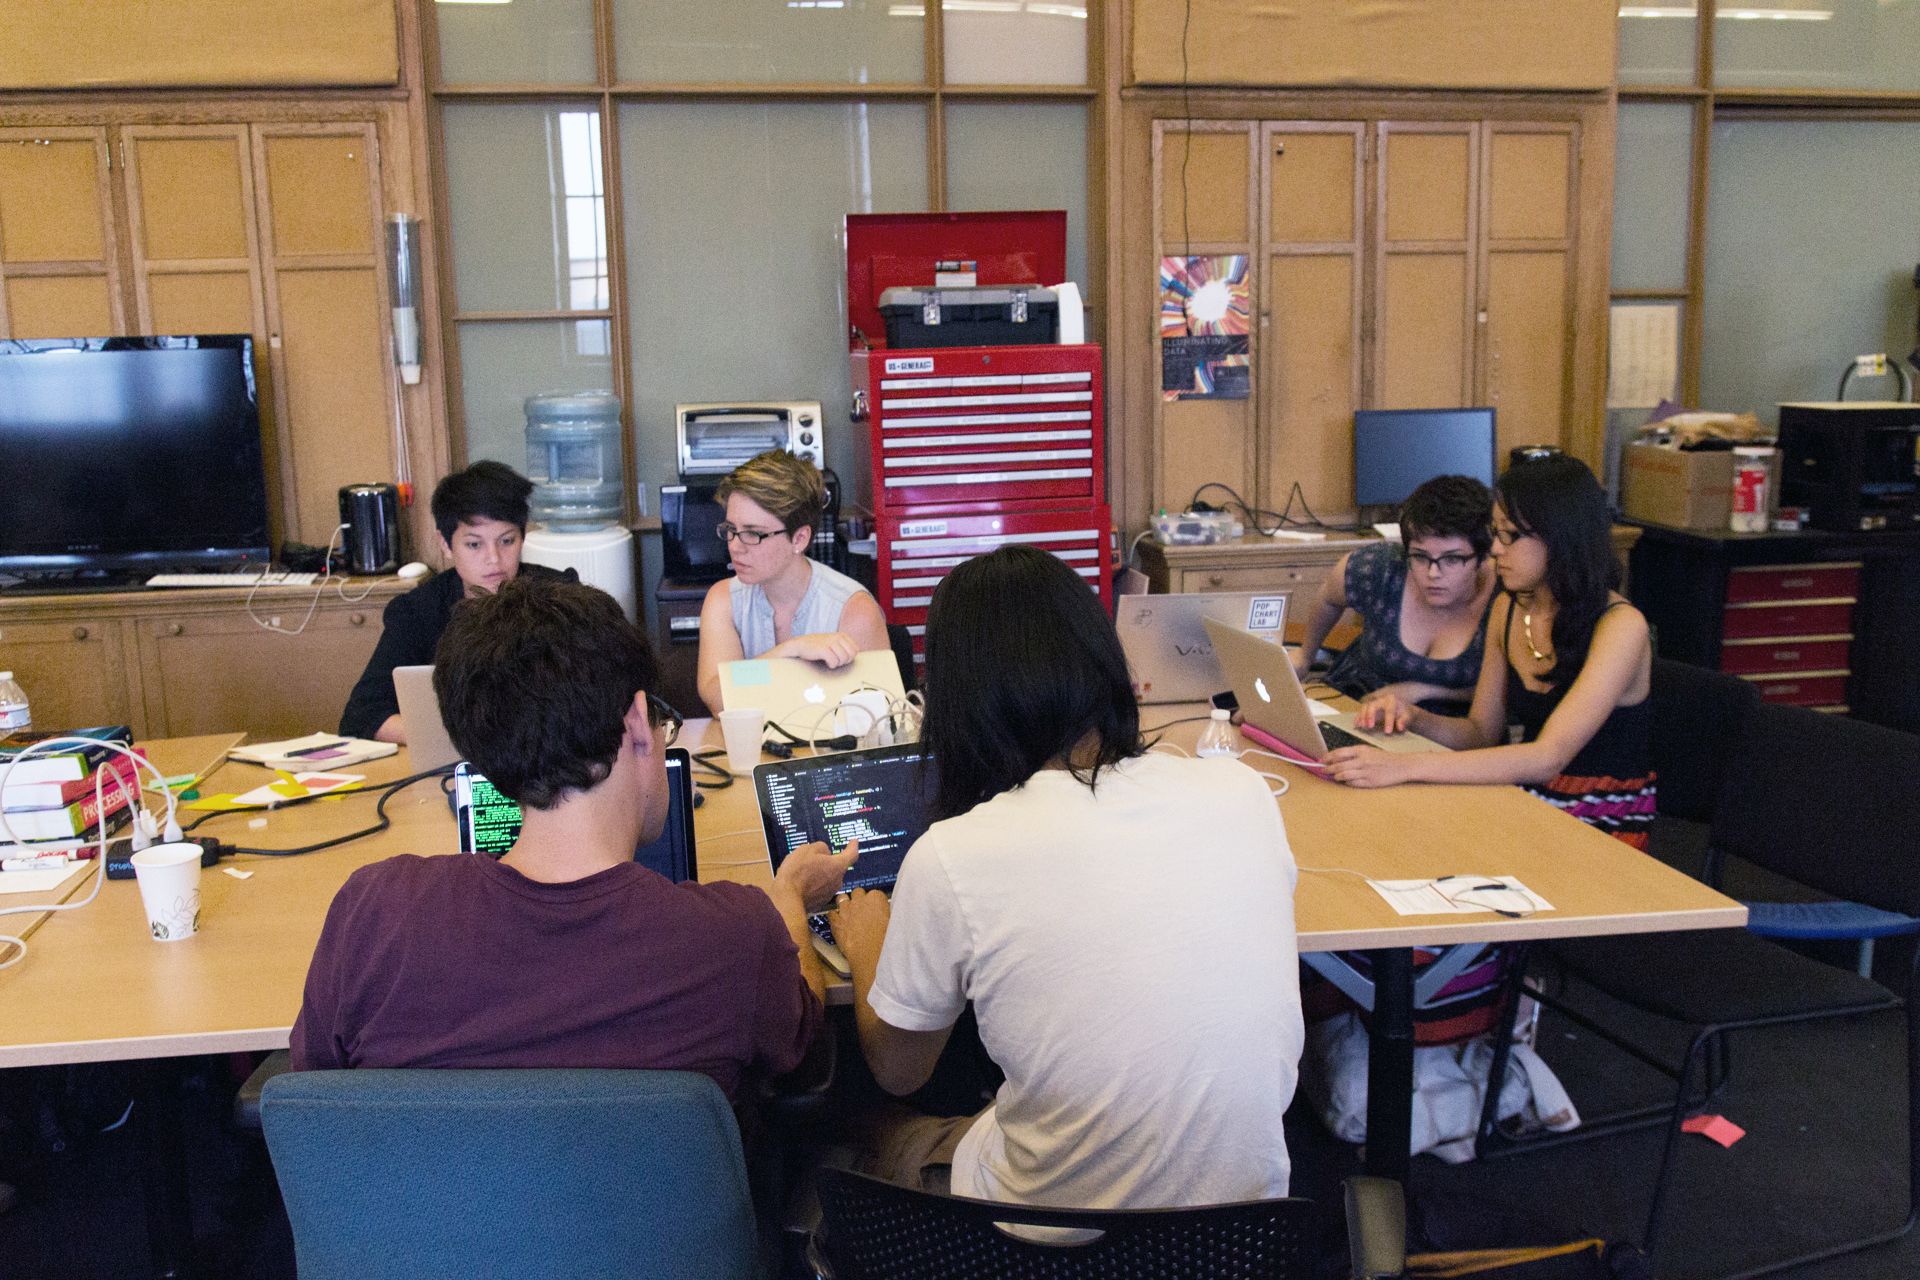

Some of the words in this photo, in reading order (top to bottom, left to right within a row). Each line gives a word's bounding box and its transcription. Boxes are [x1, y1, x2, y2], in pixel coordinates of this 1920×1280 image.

[1164, 347, 1186, 356] DATA
[1256, 602, 1270, 610] POP
[1255, 610, 1278, 618] CHART
[1253, 618, 1266, 626] LAB
